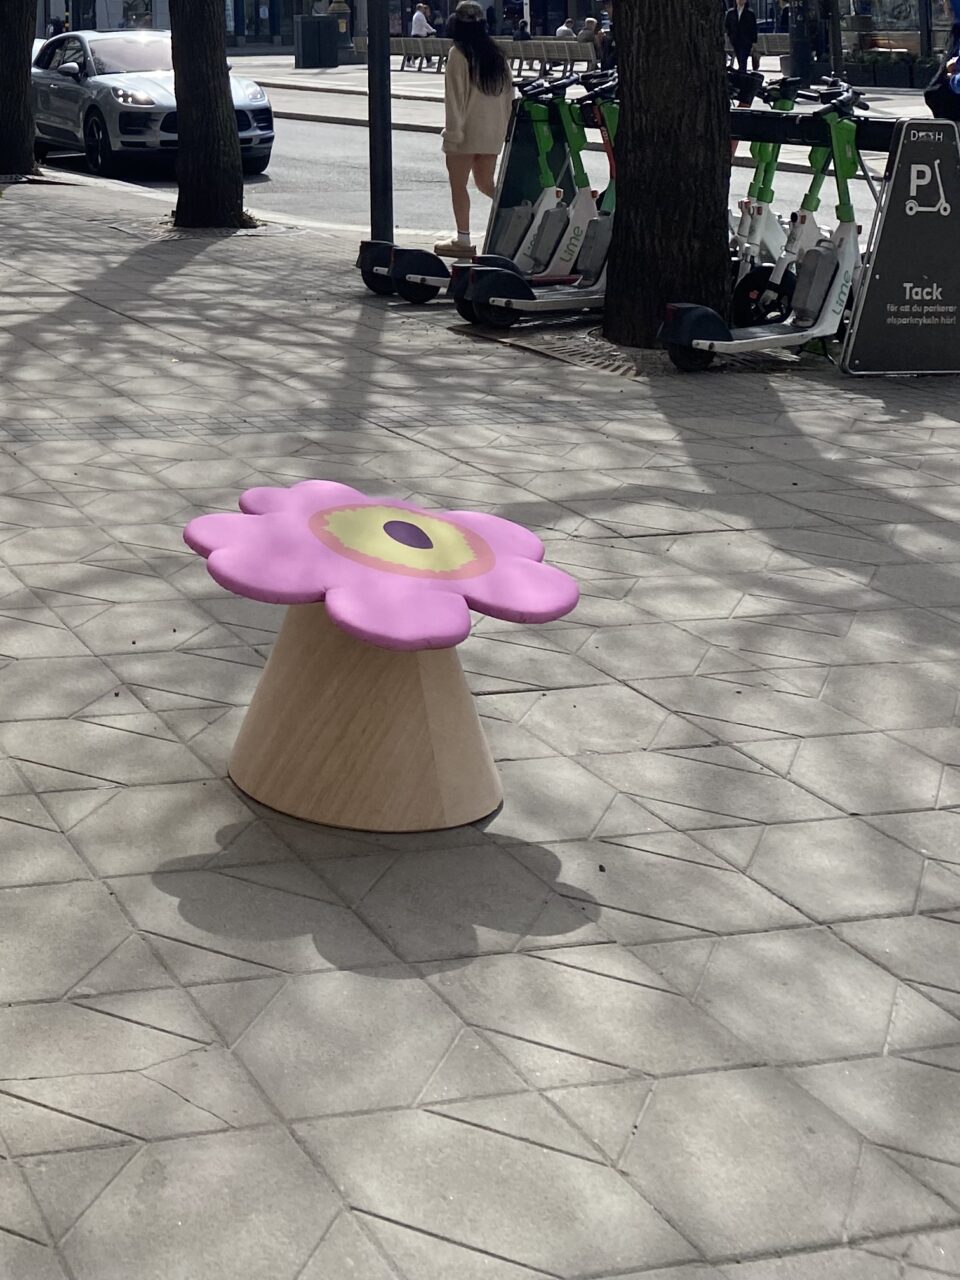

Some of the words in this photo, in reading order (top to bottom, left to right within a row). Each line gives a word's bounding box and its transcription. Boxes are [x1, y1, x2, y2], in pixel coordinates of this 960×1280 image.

[909, 164, 932, 197] P
[560, 226, 583, 263] Lime
[832, 269, 851, 316] Lime
[903, 282, 943, 300] Tack
[887, 304, 898, 312] för
[899, 304, 911, 312] att
[912, 304, 922, 312] du
[923, 304, 958, 314] parkerar
